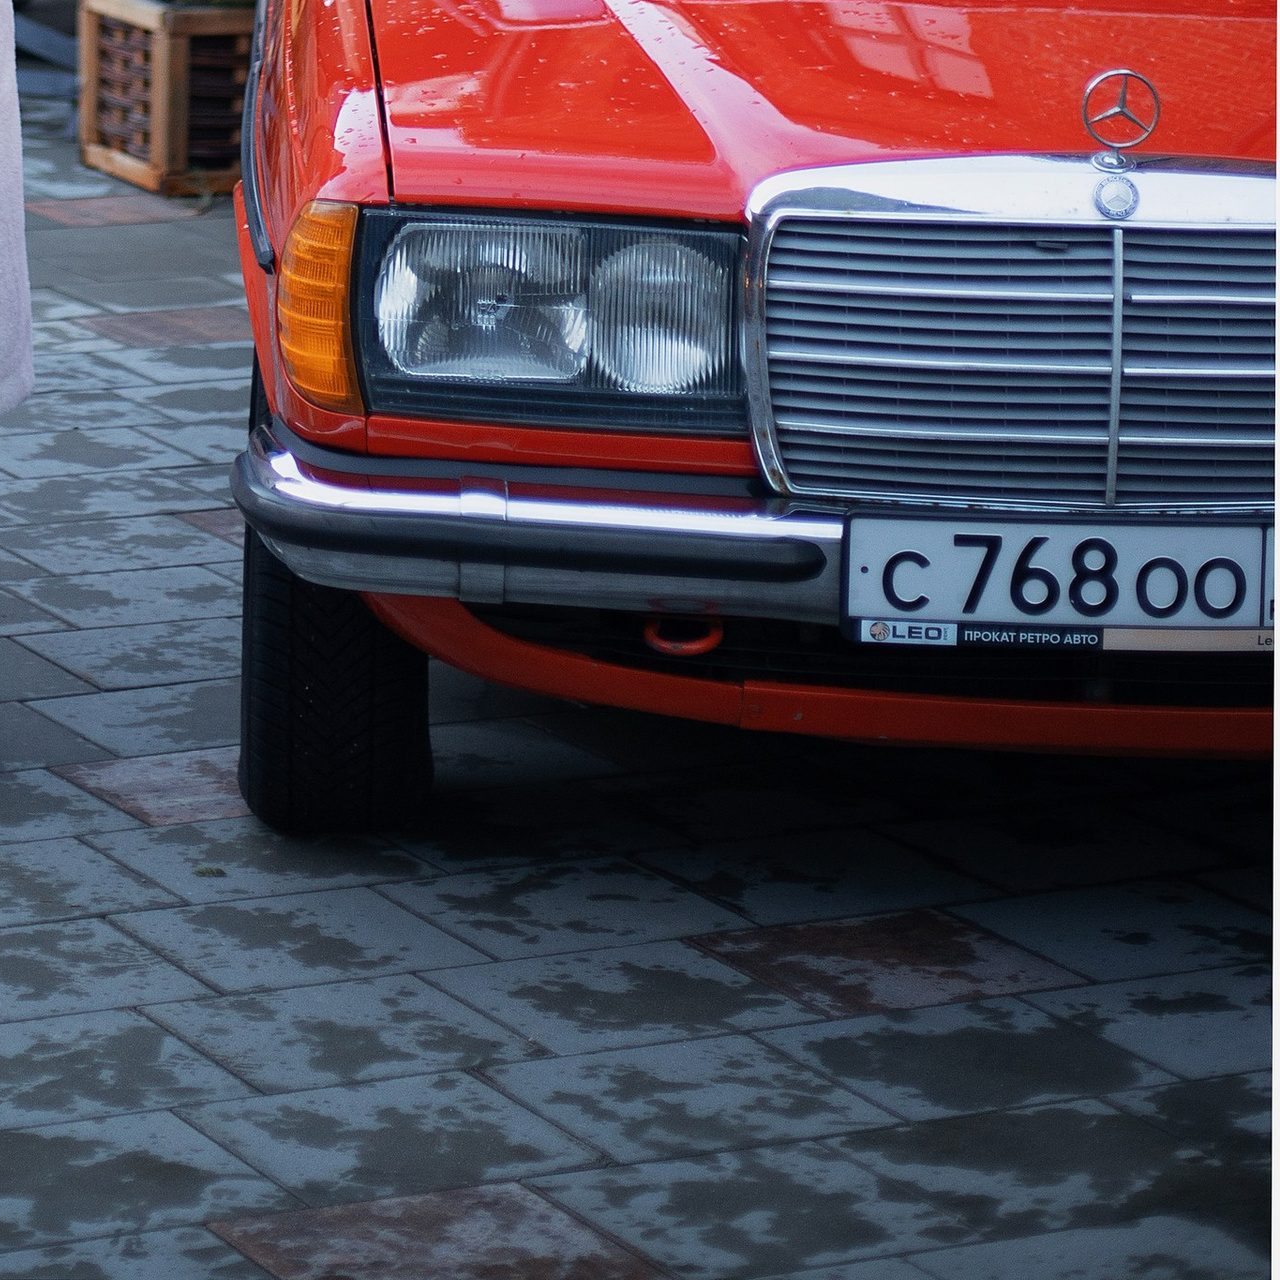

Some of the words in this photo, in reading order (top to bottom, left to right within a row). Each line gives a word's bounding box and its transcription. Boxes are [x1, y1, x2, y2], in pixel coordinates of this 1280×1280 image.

[892, 625, 942, 640] LEO
[964, 630, 1016, 643] ПРОКАТ
[1019, 632, 1061, 645] РЕТРО
[1063, 634, 1099, 645] АВТО
[1257, 635, 1275, 646] Le
